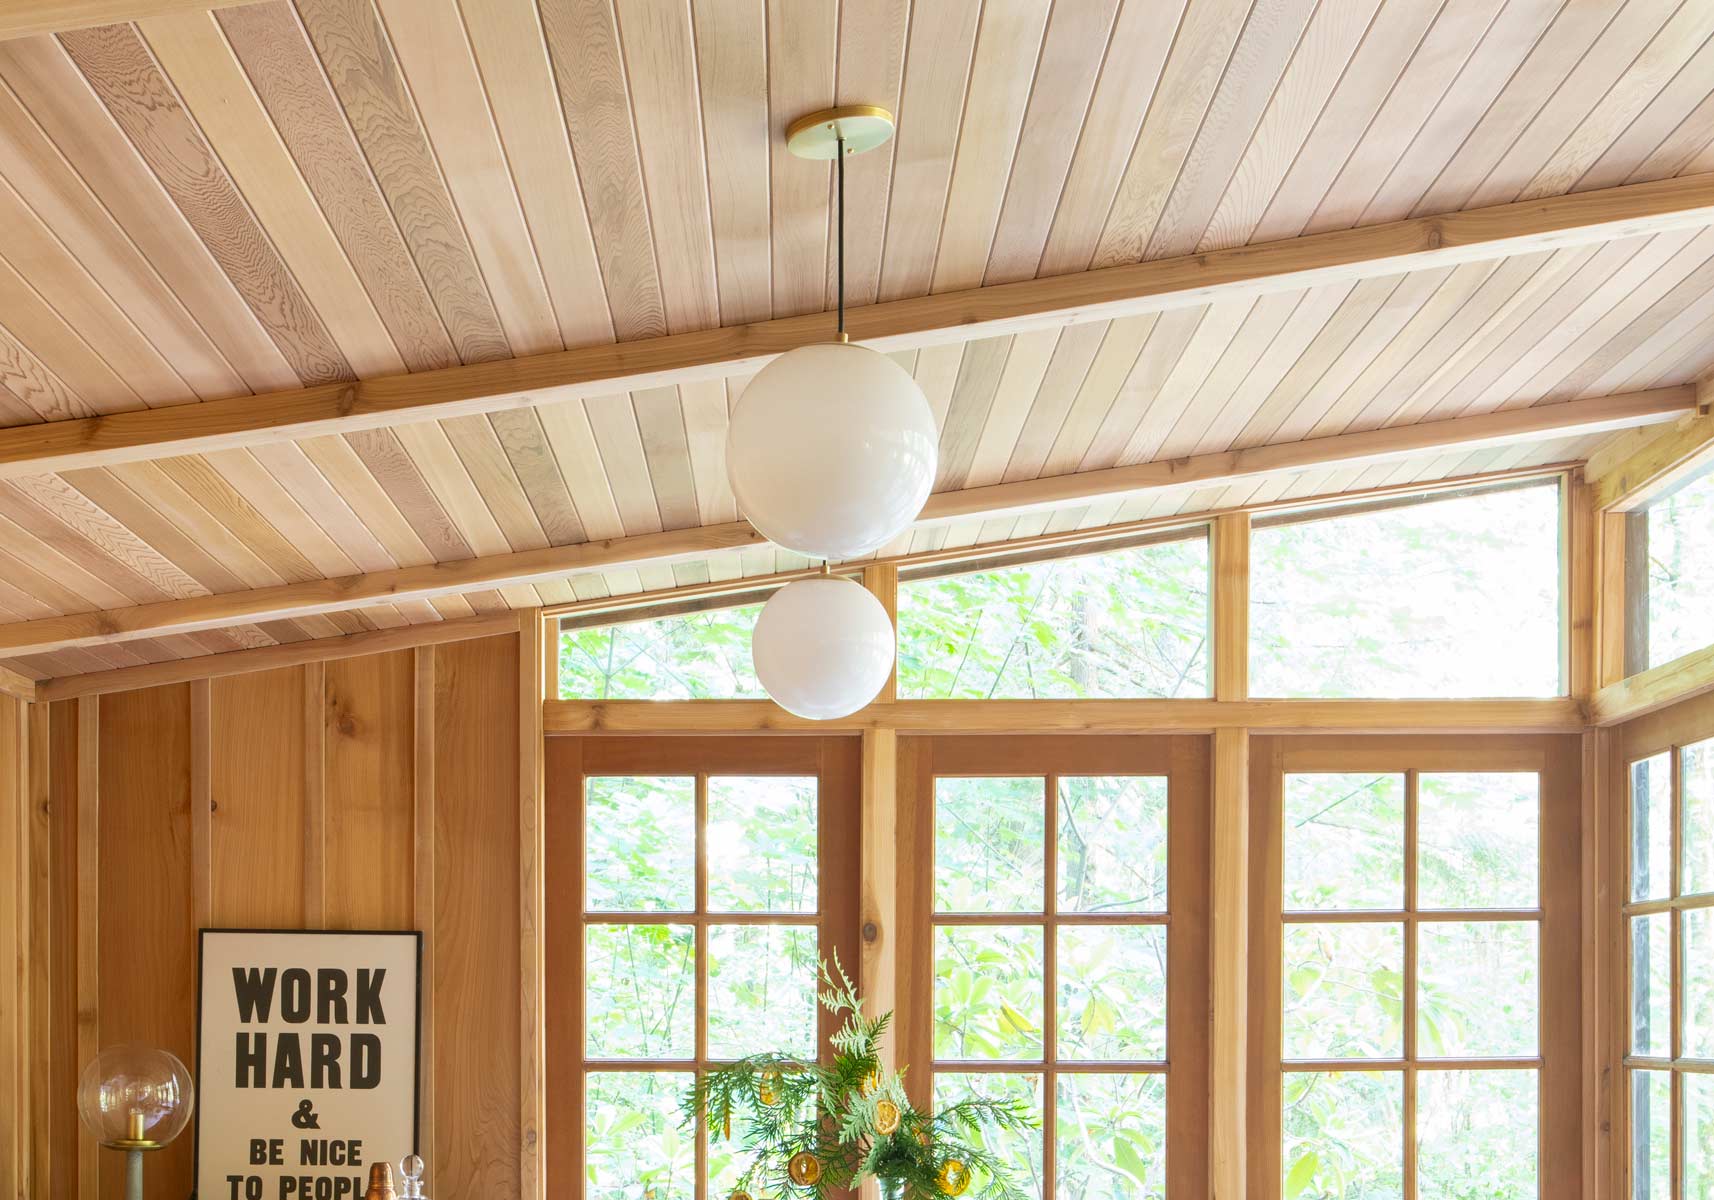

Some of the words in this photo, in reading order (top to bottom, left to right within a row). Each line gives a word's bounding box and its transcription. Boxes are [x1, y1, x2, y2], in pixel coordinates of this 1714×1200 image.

[232, 967, 387, 1025] WORK
[235, 1032, 382, 1089] HARD
[291, 1099, 320, 1129] &
[249, 1139, 284, 1165] BE
[300, 1139, 362, 1166] NICE
